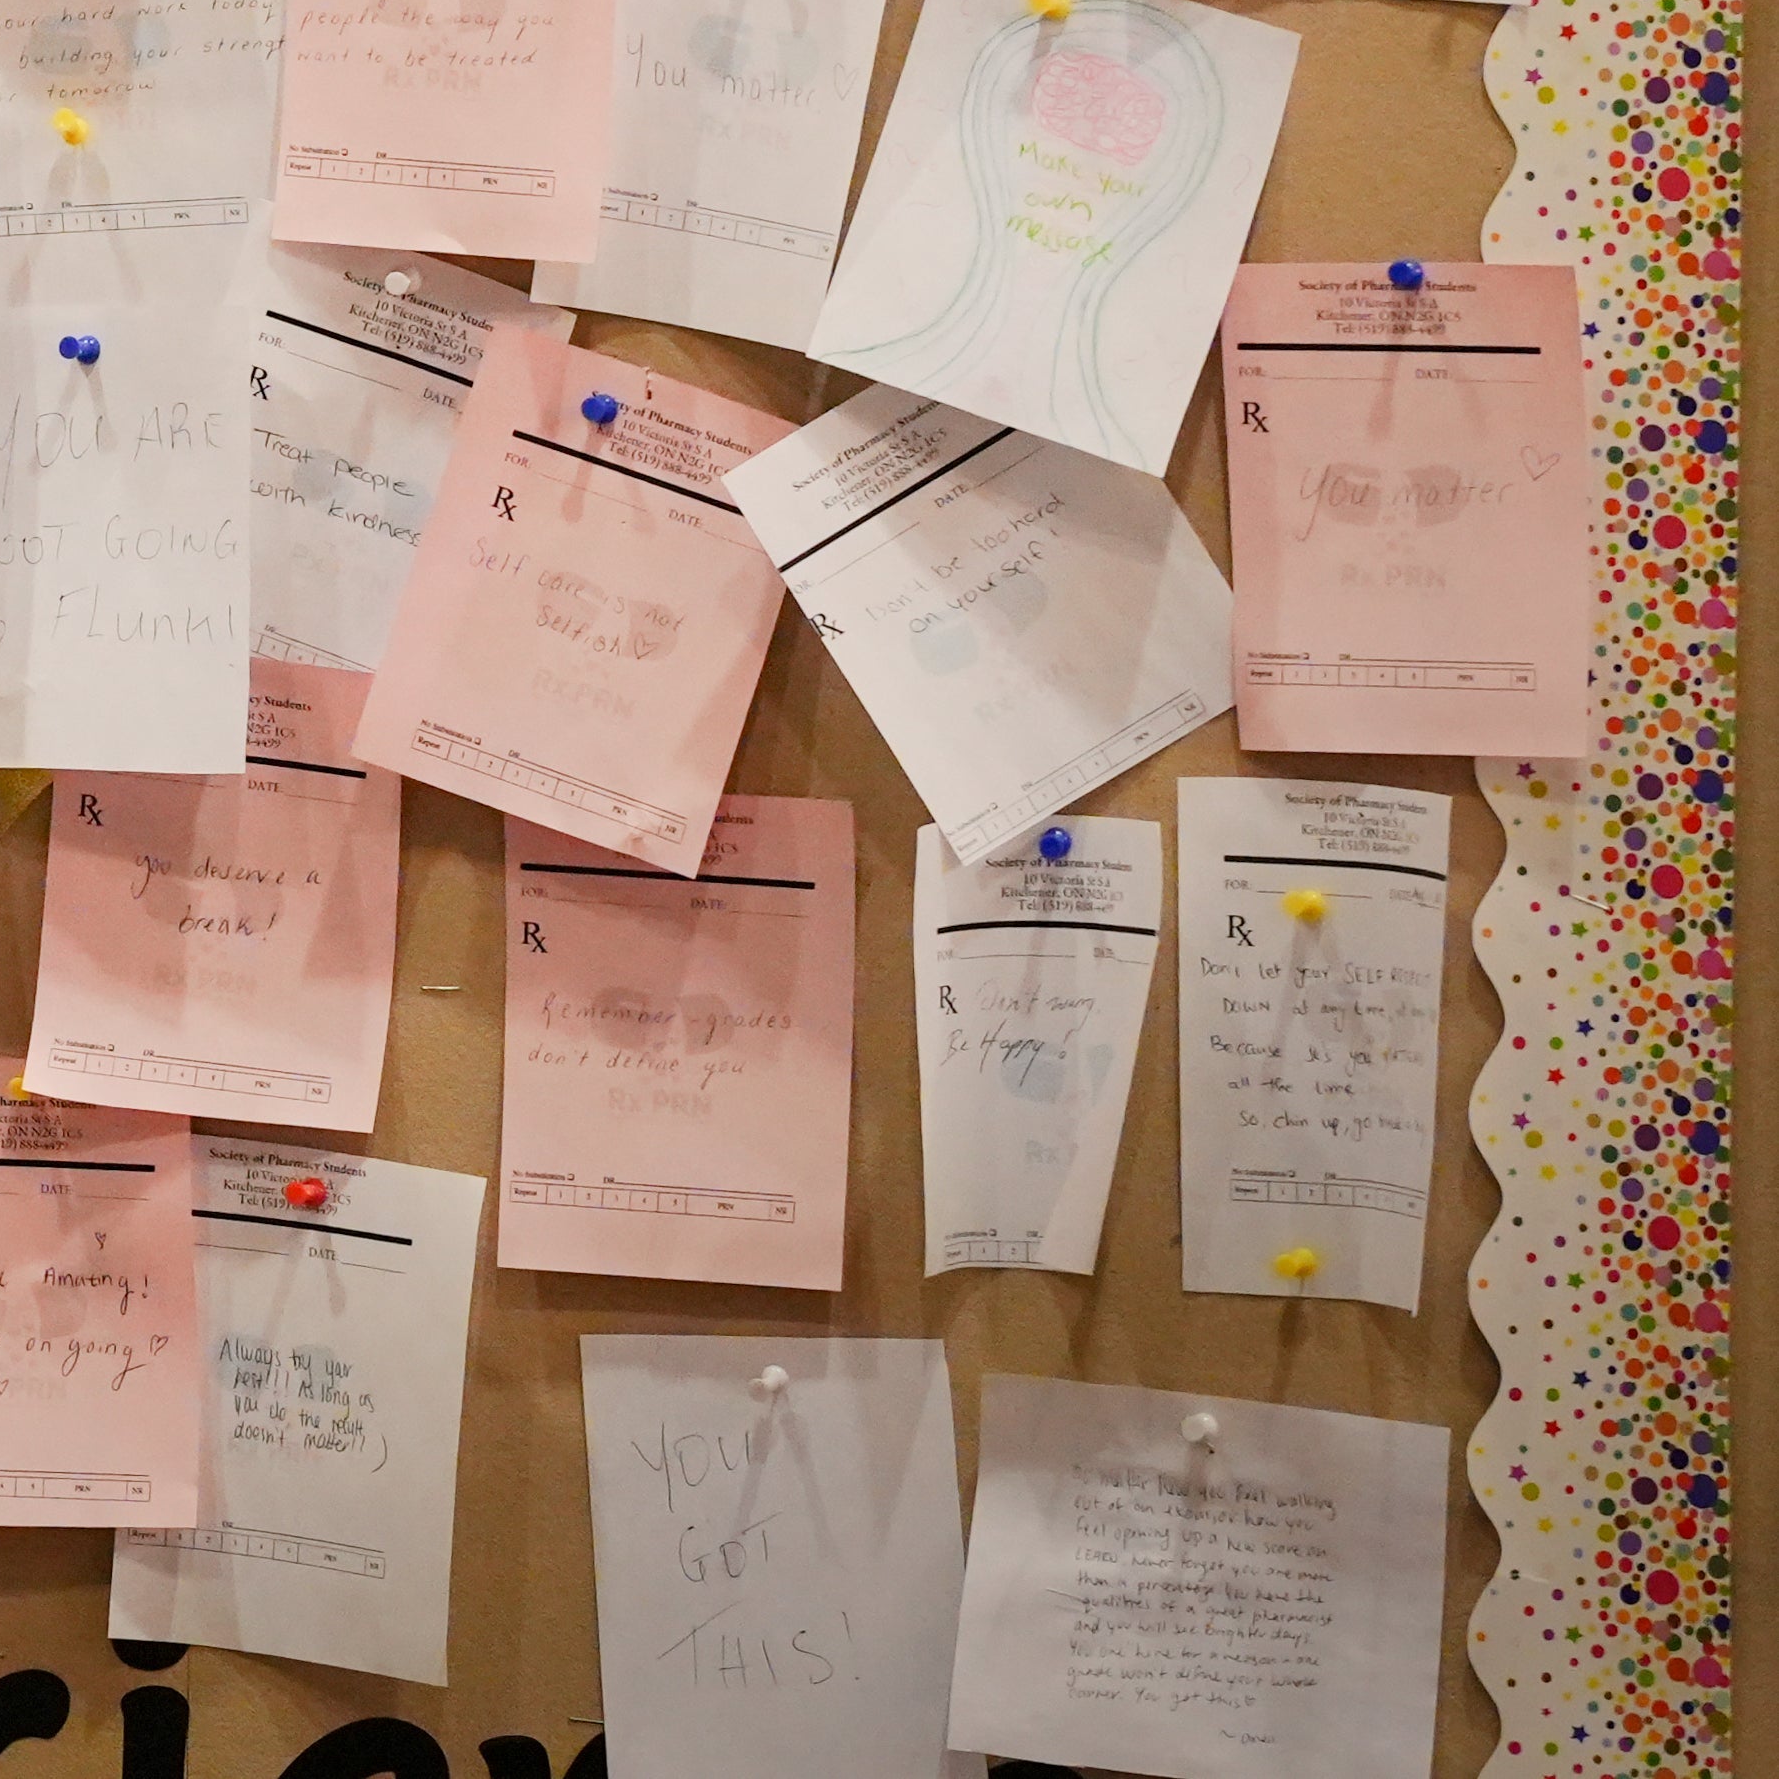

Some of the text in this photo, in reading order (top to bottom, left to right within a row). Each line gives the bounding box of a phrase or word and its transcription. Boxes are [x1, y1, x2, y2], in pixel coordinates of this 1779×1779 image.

[133, 402, 224, 462] ARE
[253, 428, 415, 497] Treat people
[249, 479, 306, 506] with
[104, 514, 240, 560] GOING
[26, 1337, 51, 1353] on
[61, 1337, 147, 1391] going
[629, 1421, 756, 1514] YOU
[677, 1510, 784, 1585] GOT
[657, 1601, 862, 1693] THIS!
